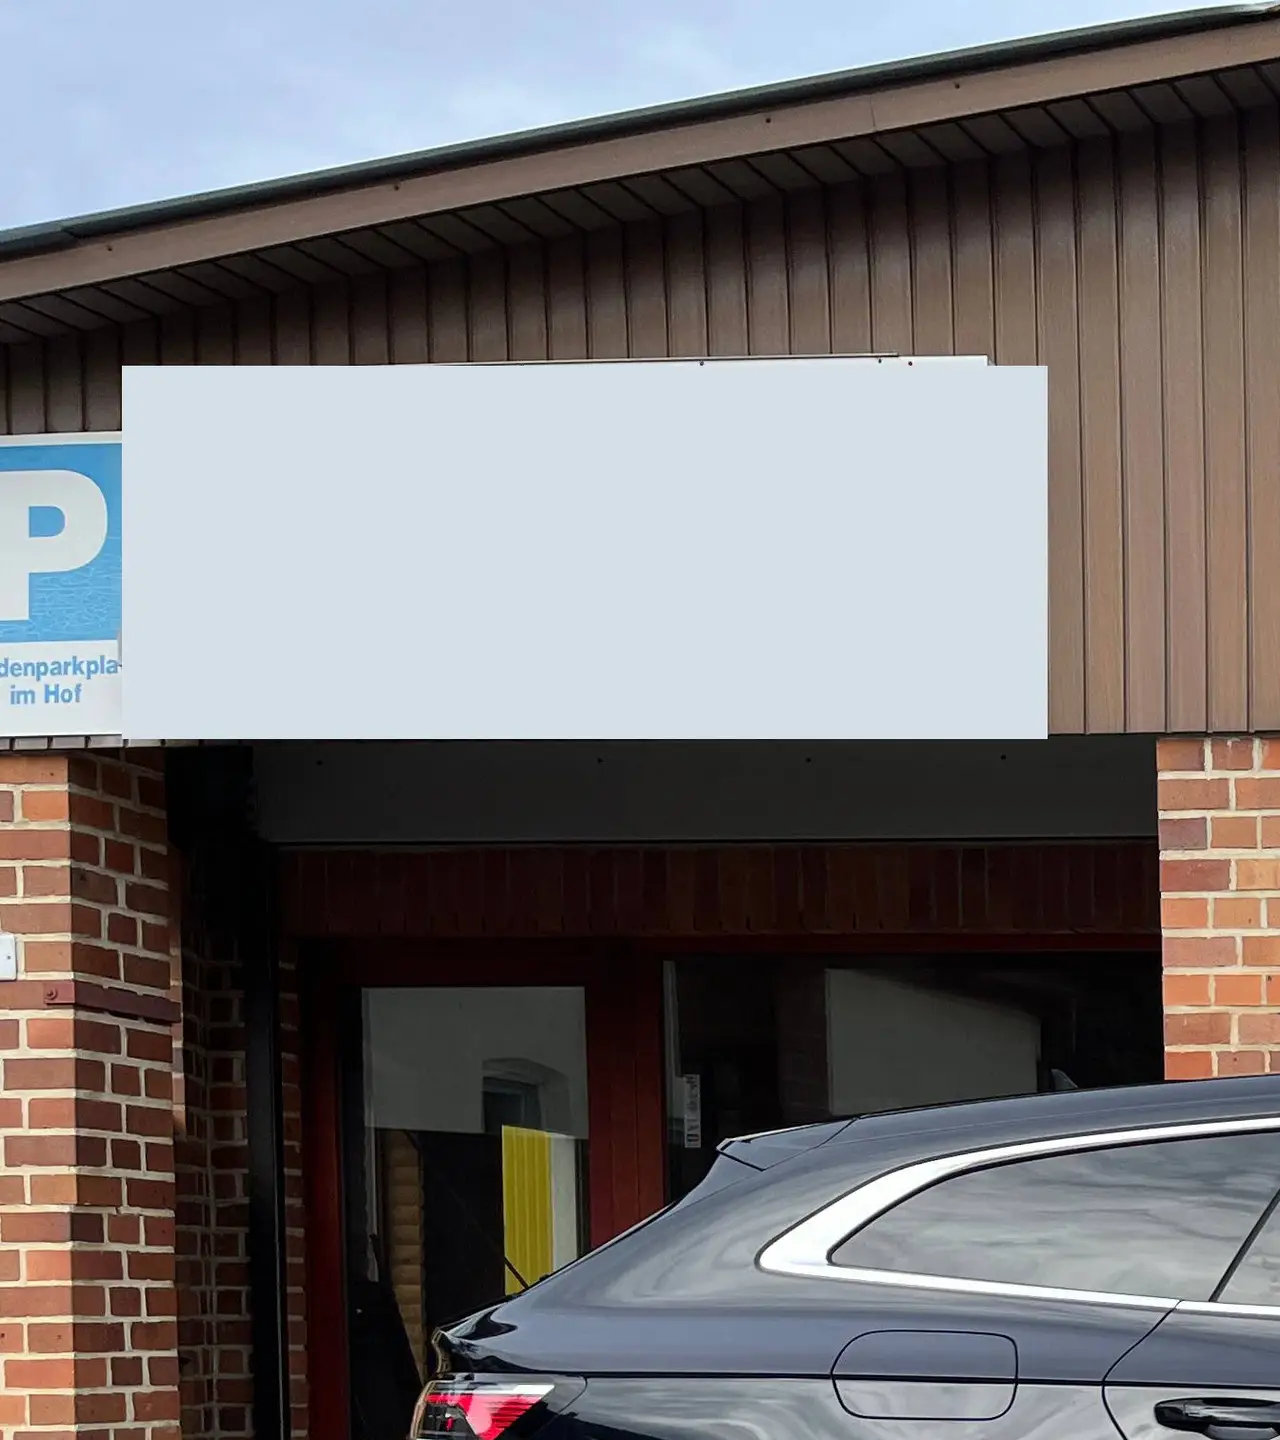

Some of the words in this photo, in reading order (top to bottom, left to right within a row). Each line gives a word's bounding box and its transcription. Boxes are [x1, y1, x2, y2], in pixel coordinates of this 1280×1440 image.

[0, 469, 108, 621] P
[10, 684, 35, 705] im
[44, 682, 81, 704] Hof
